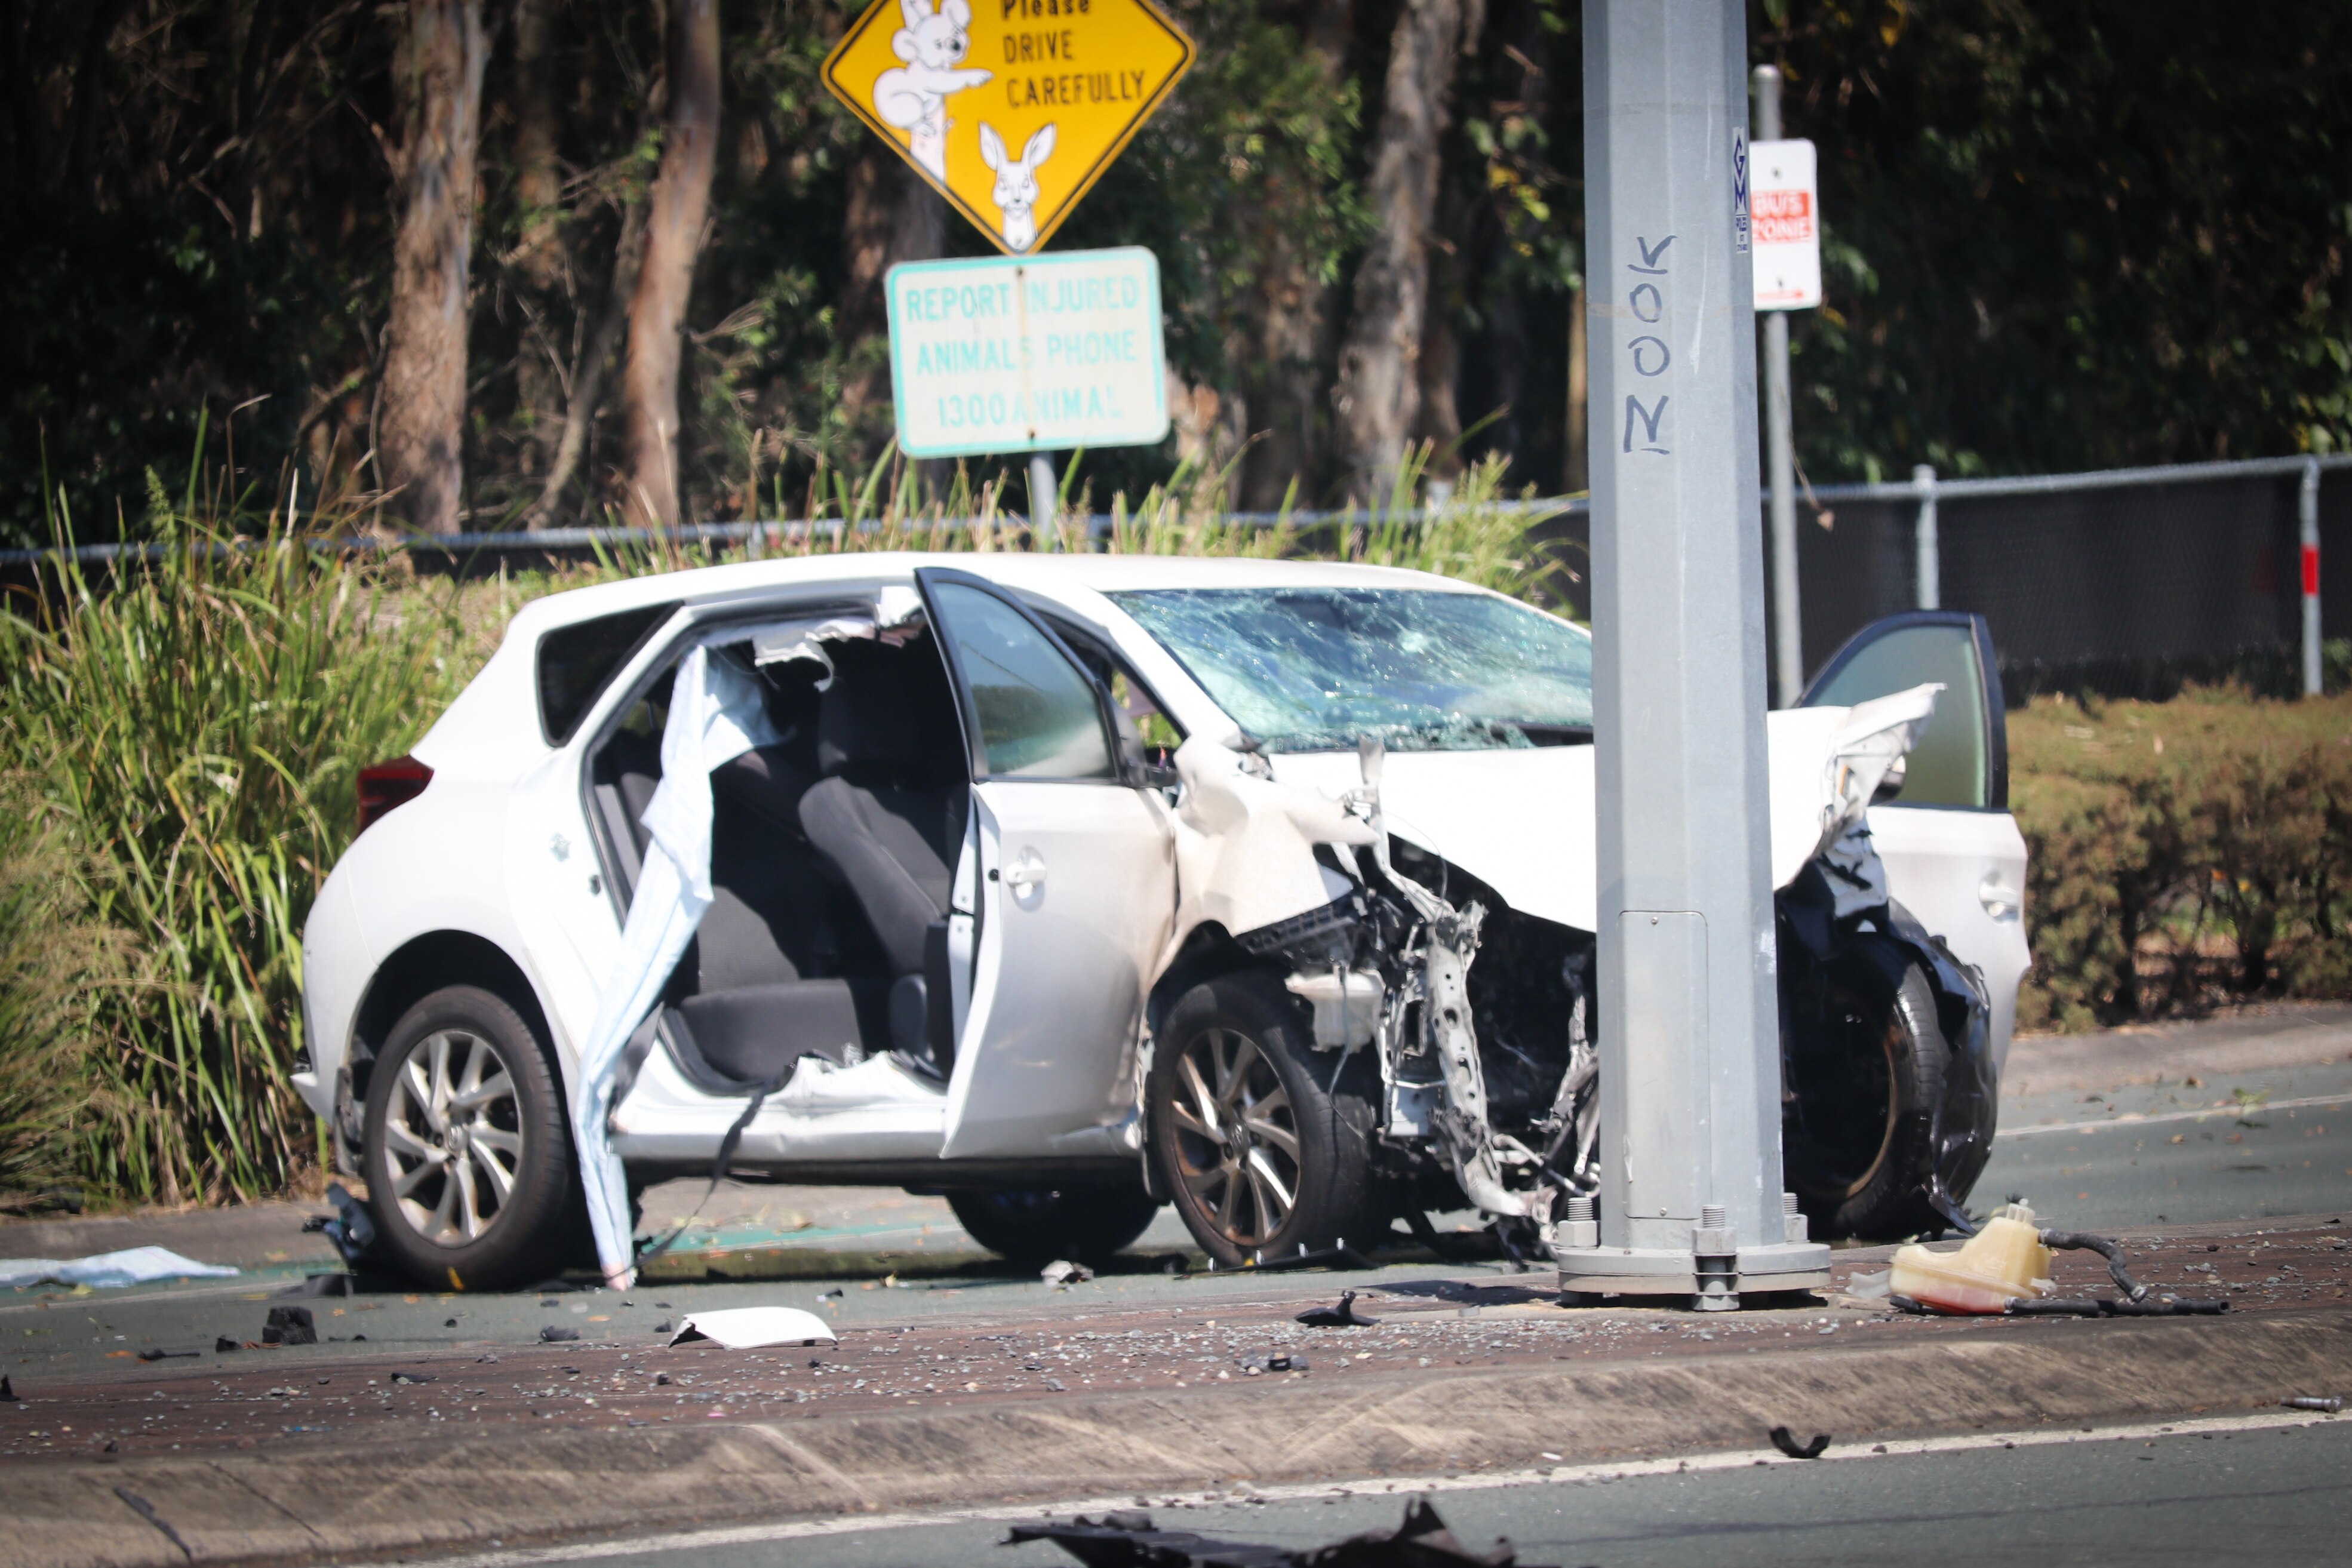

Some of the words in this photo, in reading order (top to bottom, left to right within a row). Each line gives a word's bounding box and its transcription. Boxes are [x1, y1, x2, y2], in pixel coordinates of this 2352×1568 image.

[1002, 0, 1090, 20] Please
[1003, 30, 1075, 64] DRIVE
[1006, 70, 1145, 109] CAREFULLY
[906, 282, 1010, 322] REPORT
[1022, 276, 1139, 315] INJURED
[917, 335, 1035, 377] ANIMALS
[1046, 329, 1138, 368] PHONE
[937, 391, 1007, 429] 1300
